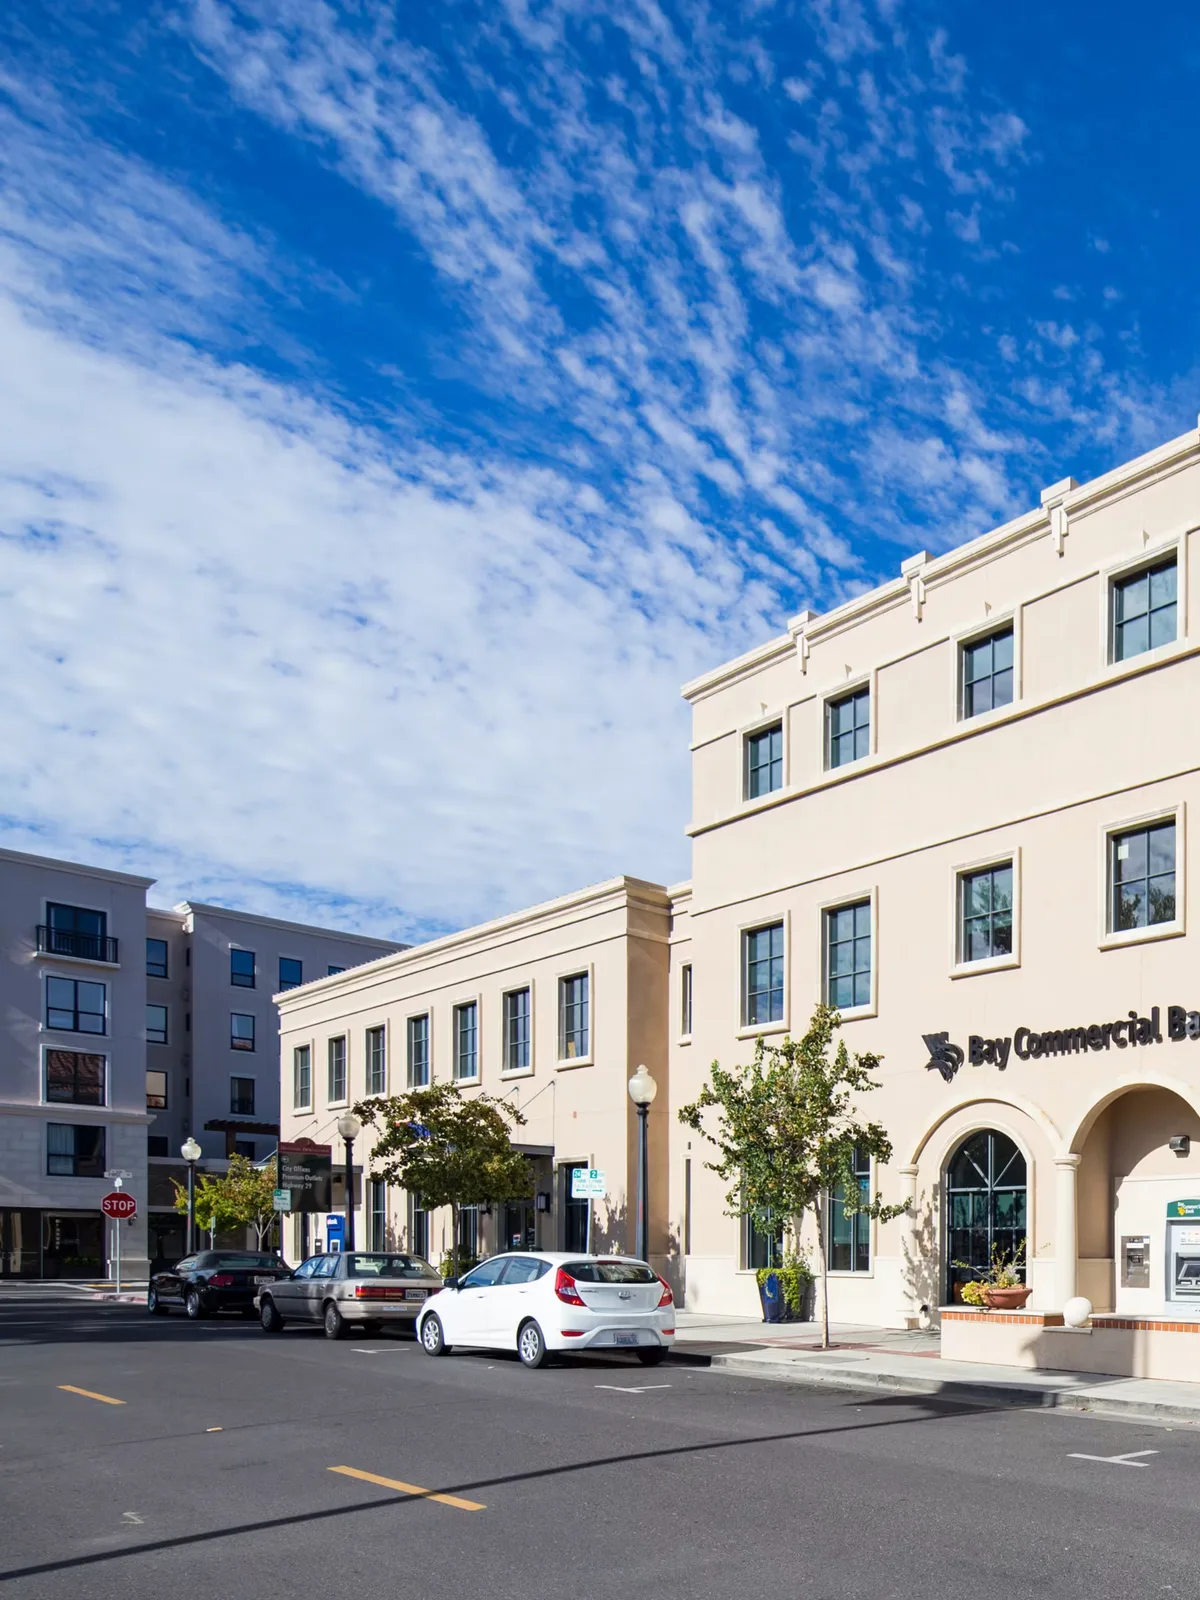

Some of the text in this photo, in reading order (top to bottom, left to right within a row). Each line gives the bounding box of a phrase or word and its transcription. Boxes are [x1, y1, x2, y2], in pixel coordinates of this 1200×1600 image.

[968, 1035, 1011, 1071] Bay
[1013, 1006, 1163, 1061] Commercial
[293, 1165, 311, 1173] Offices
[282, 1173, 323, 1182] Premium Outlets
[282, 1181, 304, 1190] Highway
[103, 1200, 135, 1211] STOP
